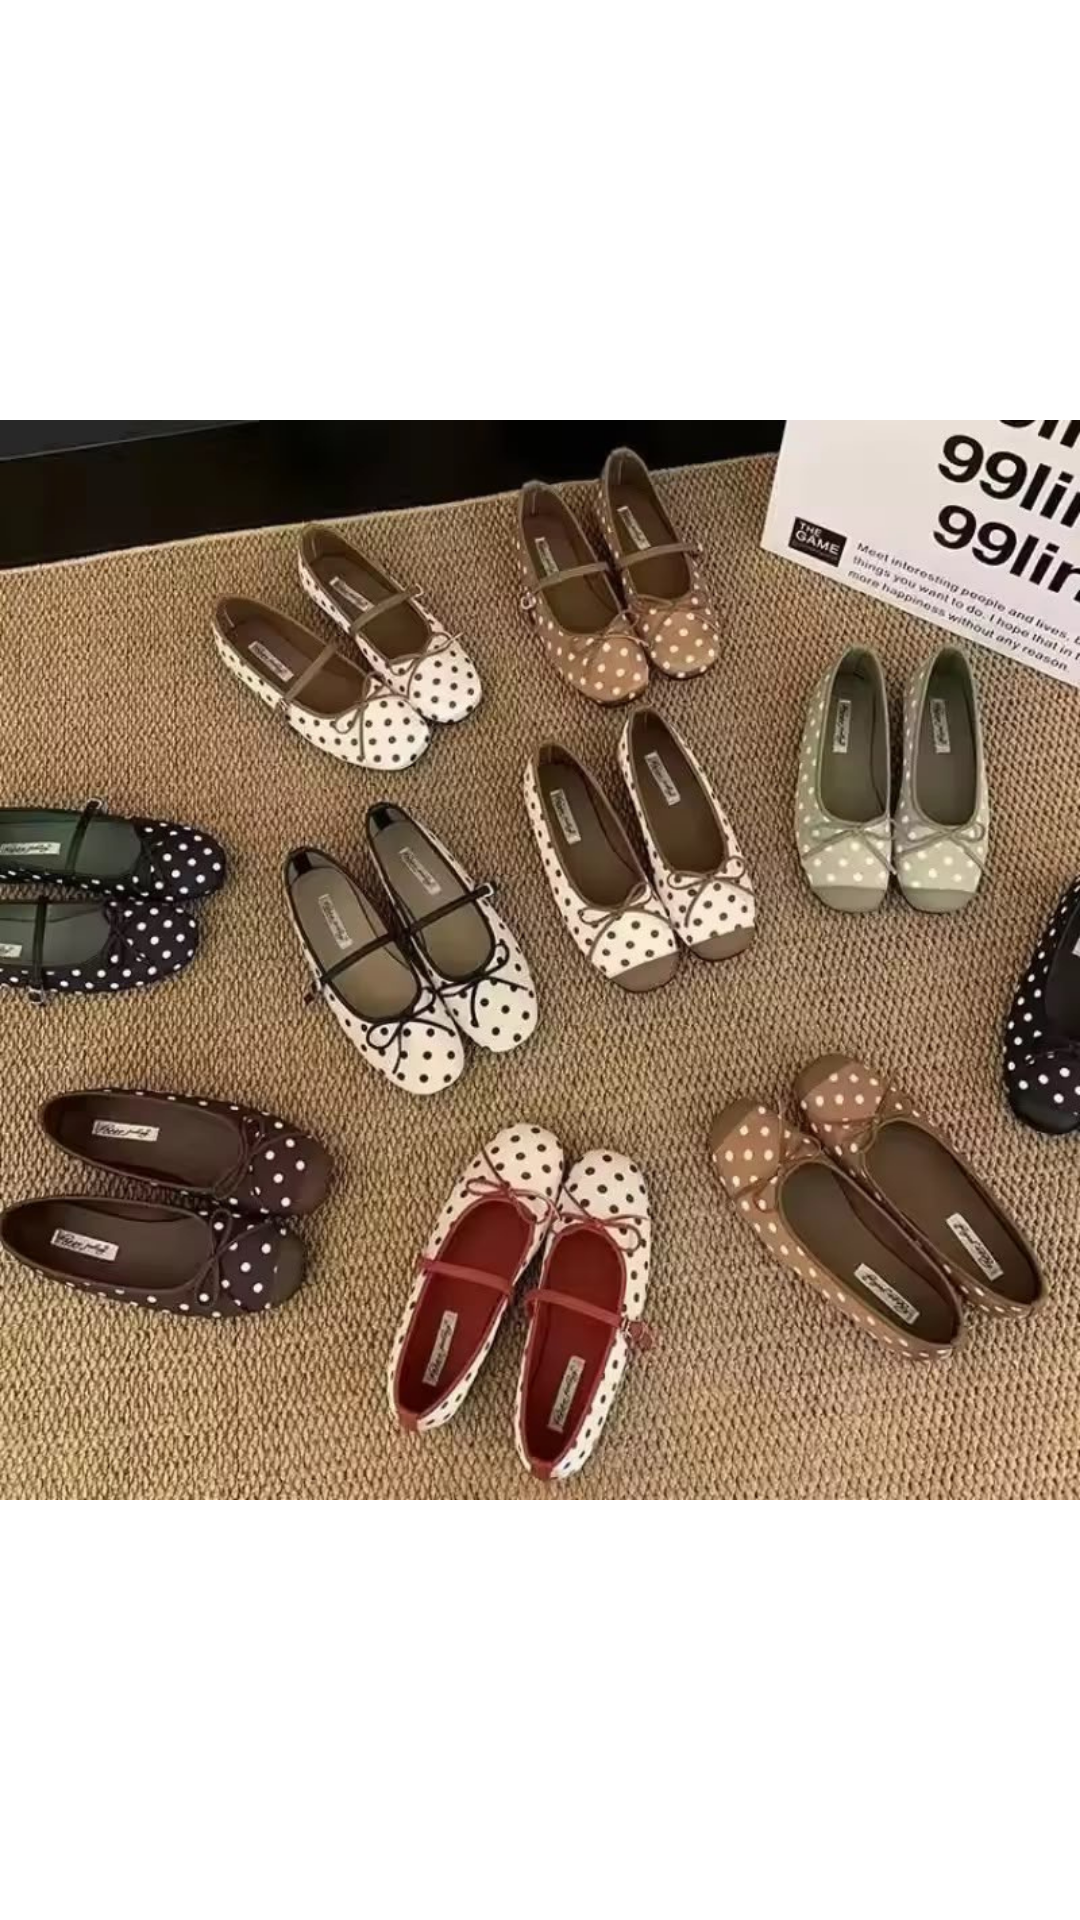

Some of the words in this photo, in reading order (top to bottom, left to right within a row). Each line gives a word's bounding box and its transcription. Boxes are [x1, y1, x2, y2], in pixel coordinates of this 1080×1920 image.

[795, 530, 840, 556] GAME
[800, 521, 822, 538] THE
[848, 569, 881, 588] more
[882, 582, 946, 618] happiness
[948, 612, 995, 639] without
[995, 634, 1021, 651] any
[853, 555, 891, 578] things
[894, 573, 917, 590] you
[918, 584, 950, 603] want
[951, 597, 965, 610] to
[966, 604, 986, 619] do.
[989, 613, 996, 622] I
[996, 617, 1030, 638] hope
[1032, 633, 1058, 651] that
[1059, 645, 1073, 657] in
[857, 542, 890, 562] Meet
[891, 557, 960, 593] interesting
[960, 588, 1006, 613] people
[1008, 609, 1035, 624] and
